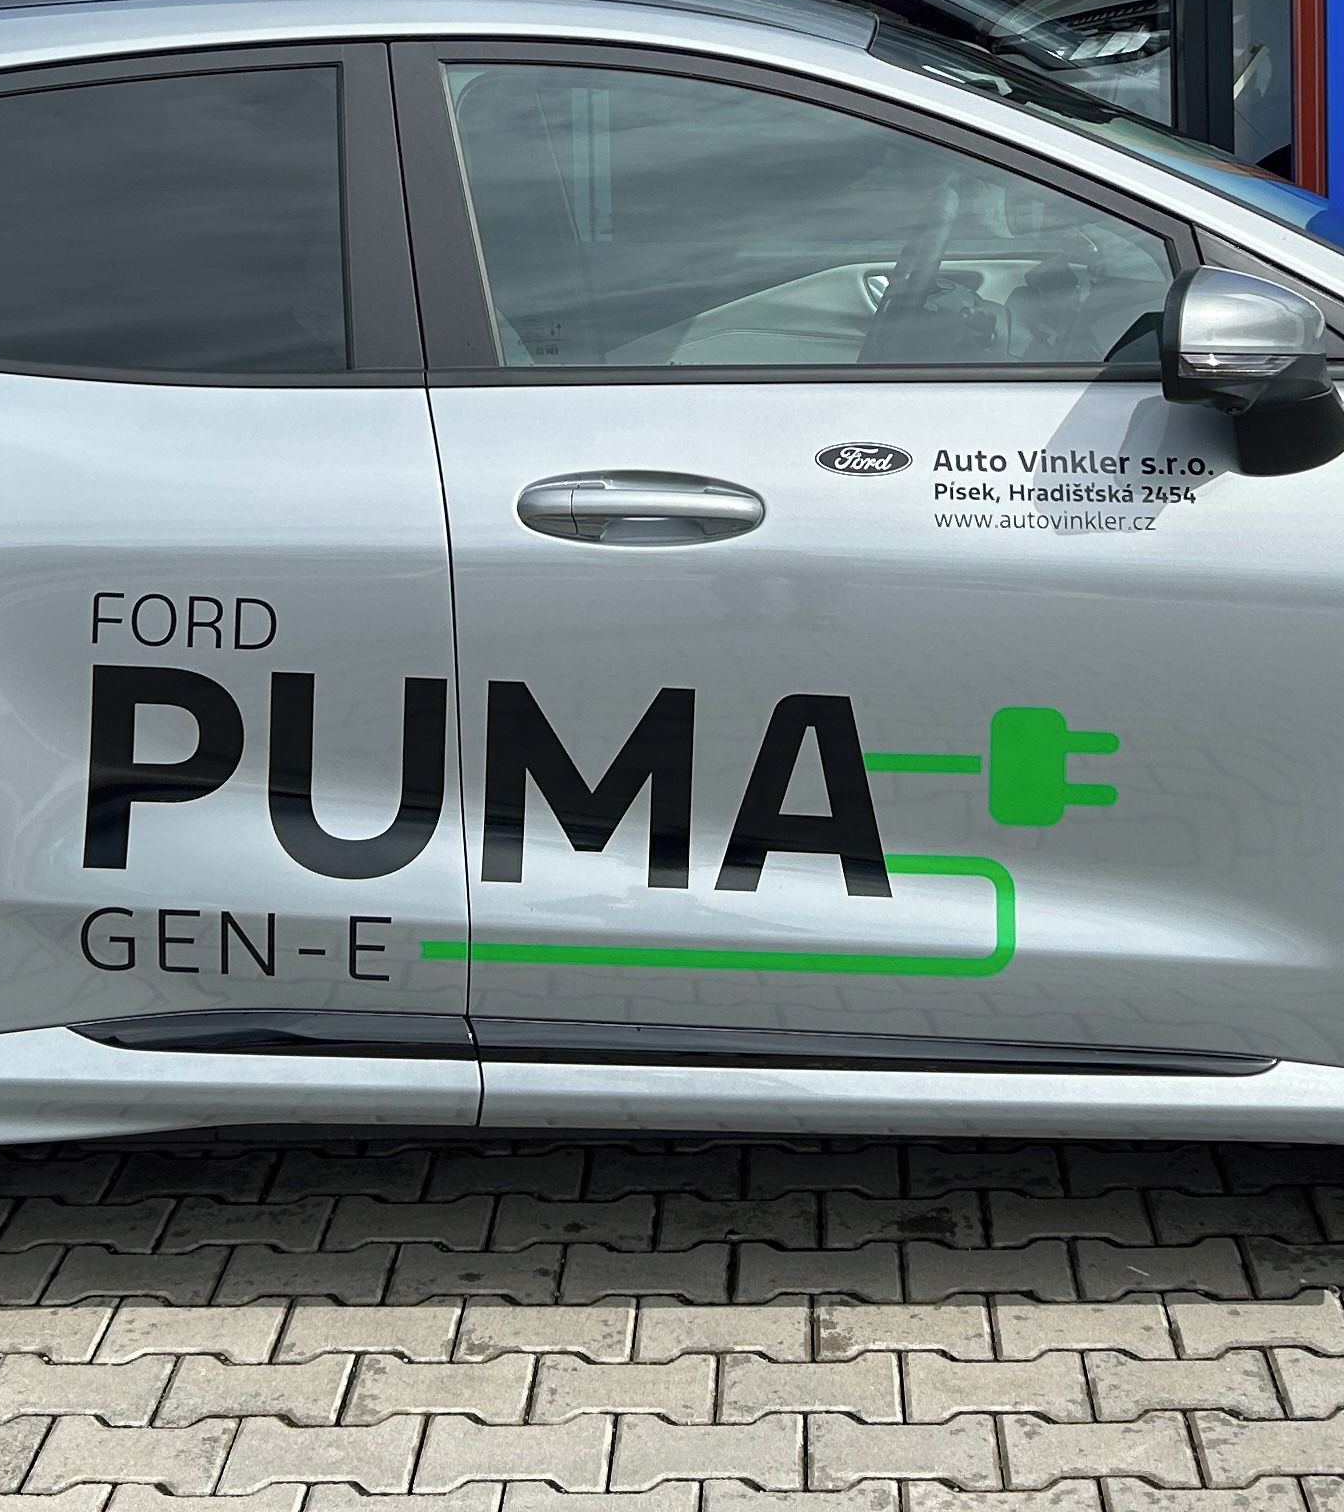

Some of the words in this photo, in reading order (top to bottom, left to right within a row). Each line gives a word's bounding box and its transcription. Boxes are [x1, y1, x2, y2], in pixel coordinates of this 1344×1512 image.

[833, 444, 893, 473] Ford
[932, 450, 1009, 474] Auto
[1018, 449, 1131, 476] Vinkler
[1140, 455, 1214, 477] s.r.o.
[934, 481, 1001, 504] Písek,
[1009, 482, 1134, 505] Hradišťská
[1141, 484, 1197, 505] 2454
[934, 510, 1157, 532] www.autovinkler.cz
[91, 591, 278, 651] FORD
[81, 663, 893, 898] PUMA
[79, 905, 393, 981] GEN-E
